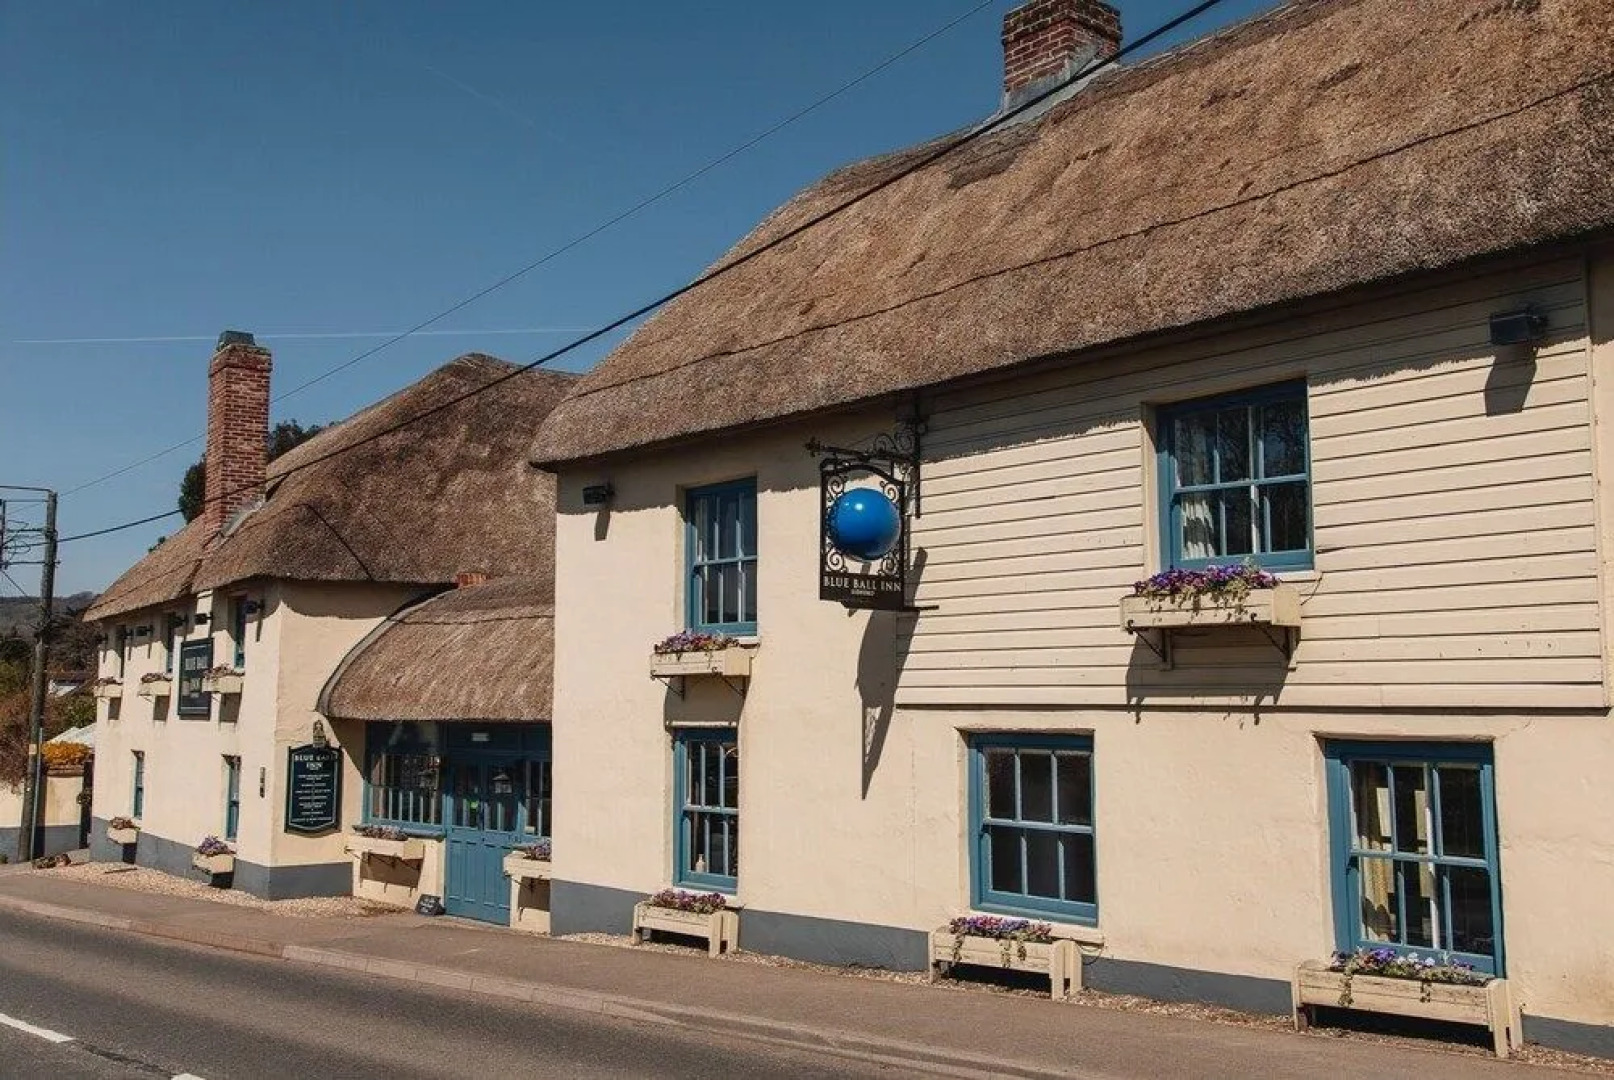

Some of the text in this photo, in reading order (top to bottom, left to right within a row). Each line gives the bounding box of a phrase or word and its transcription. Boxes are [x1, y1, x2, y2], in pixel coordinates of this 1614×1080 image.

[823, 576, 902, 592] BLUE BALL INN
